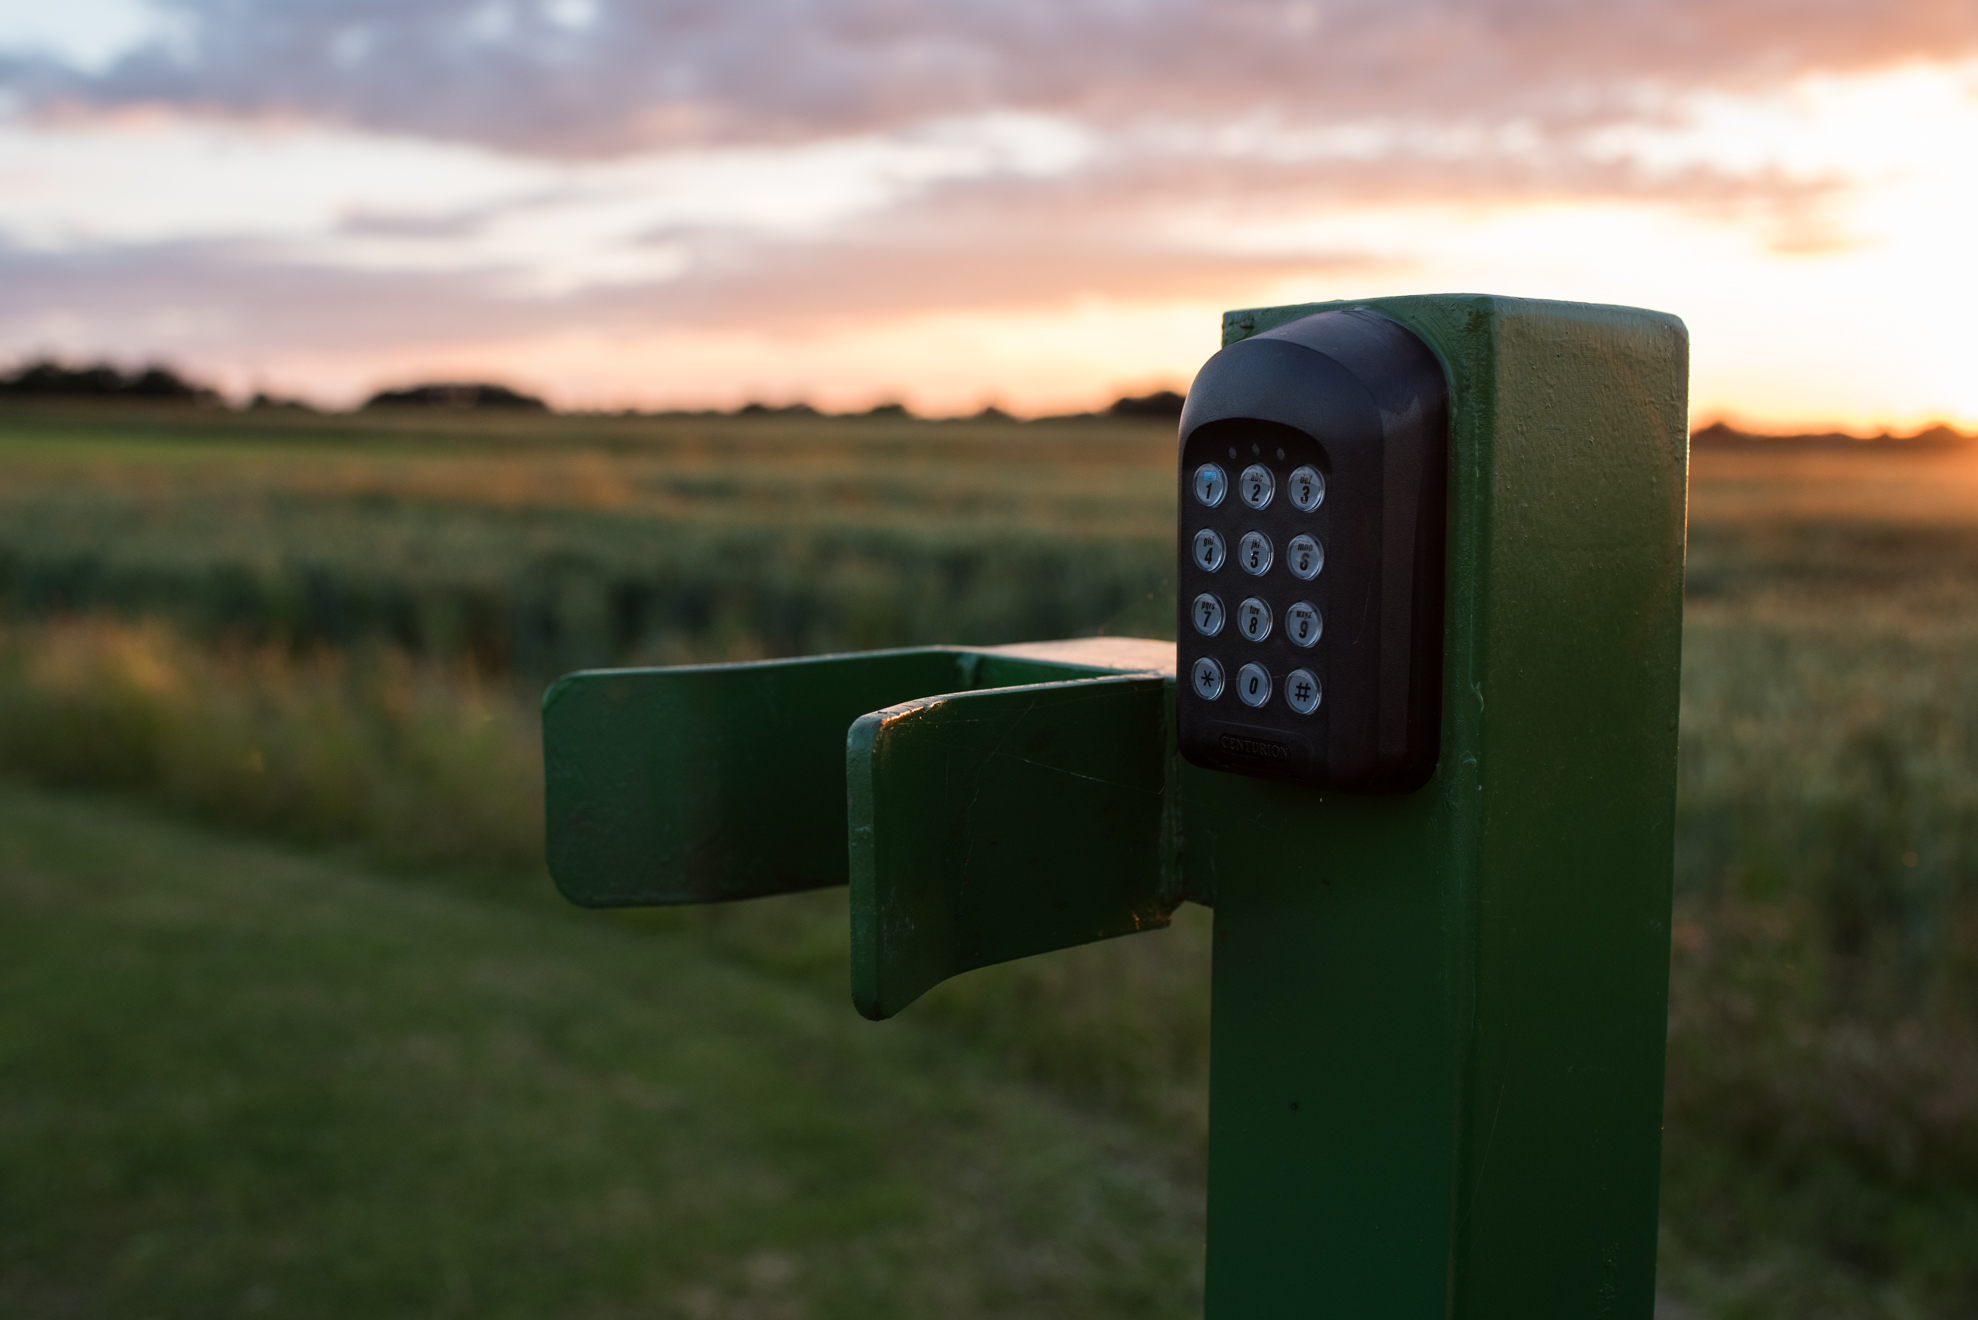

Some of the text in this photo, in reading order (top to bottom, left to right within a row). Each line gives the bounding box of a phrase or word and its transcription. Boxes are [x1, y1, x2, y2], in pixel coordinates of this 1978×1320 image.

[1250, 473, 1264, 482] abc
[1206, 482, 1212, 499] 1
[1251, 484, 1260, 502] 2
[1301, 486, 1310, 504] 3
[1203, 536, 1215, 547] ghi
[1204, 548, 1213, 564] 4
[1250, 551, 1259, 568] 5
[1203, 611, 1212, 627] 7
[1249, 617, 1258, 634] 8
[1299, 621, 1308, 638] 9
[1249, 677, 1258, 694] 0
[1221, 736, 1289, 759] CENTURION
